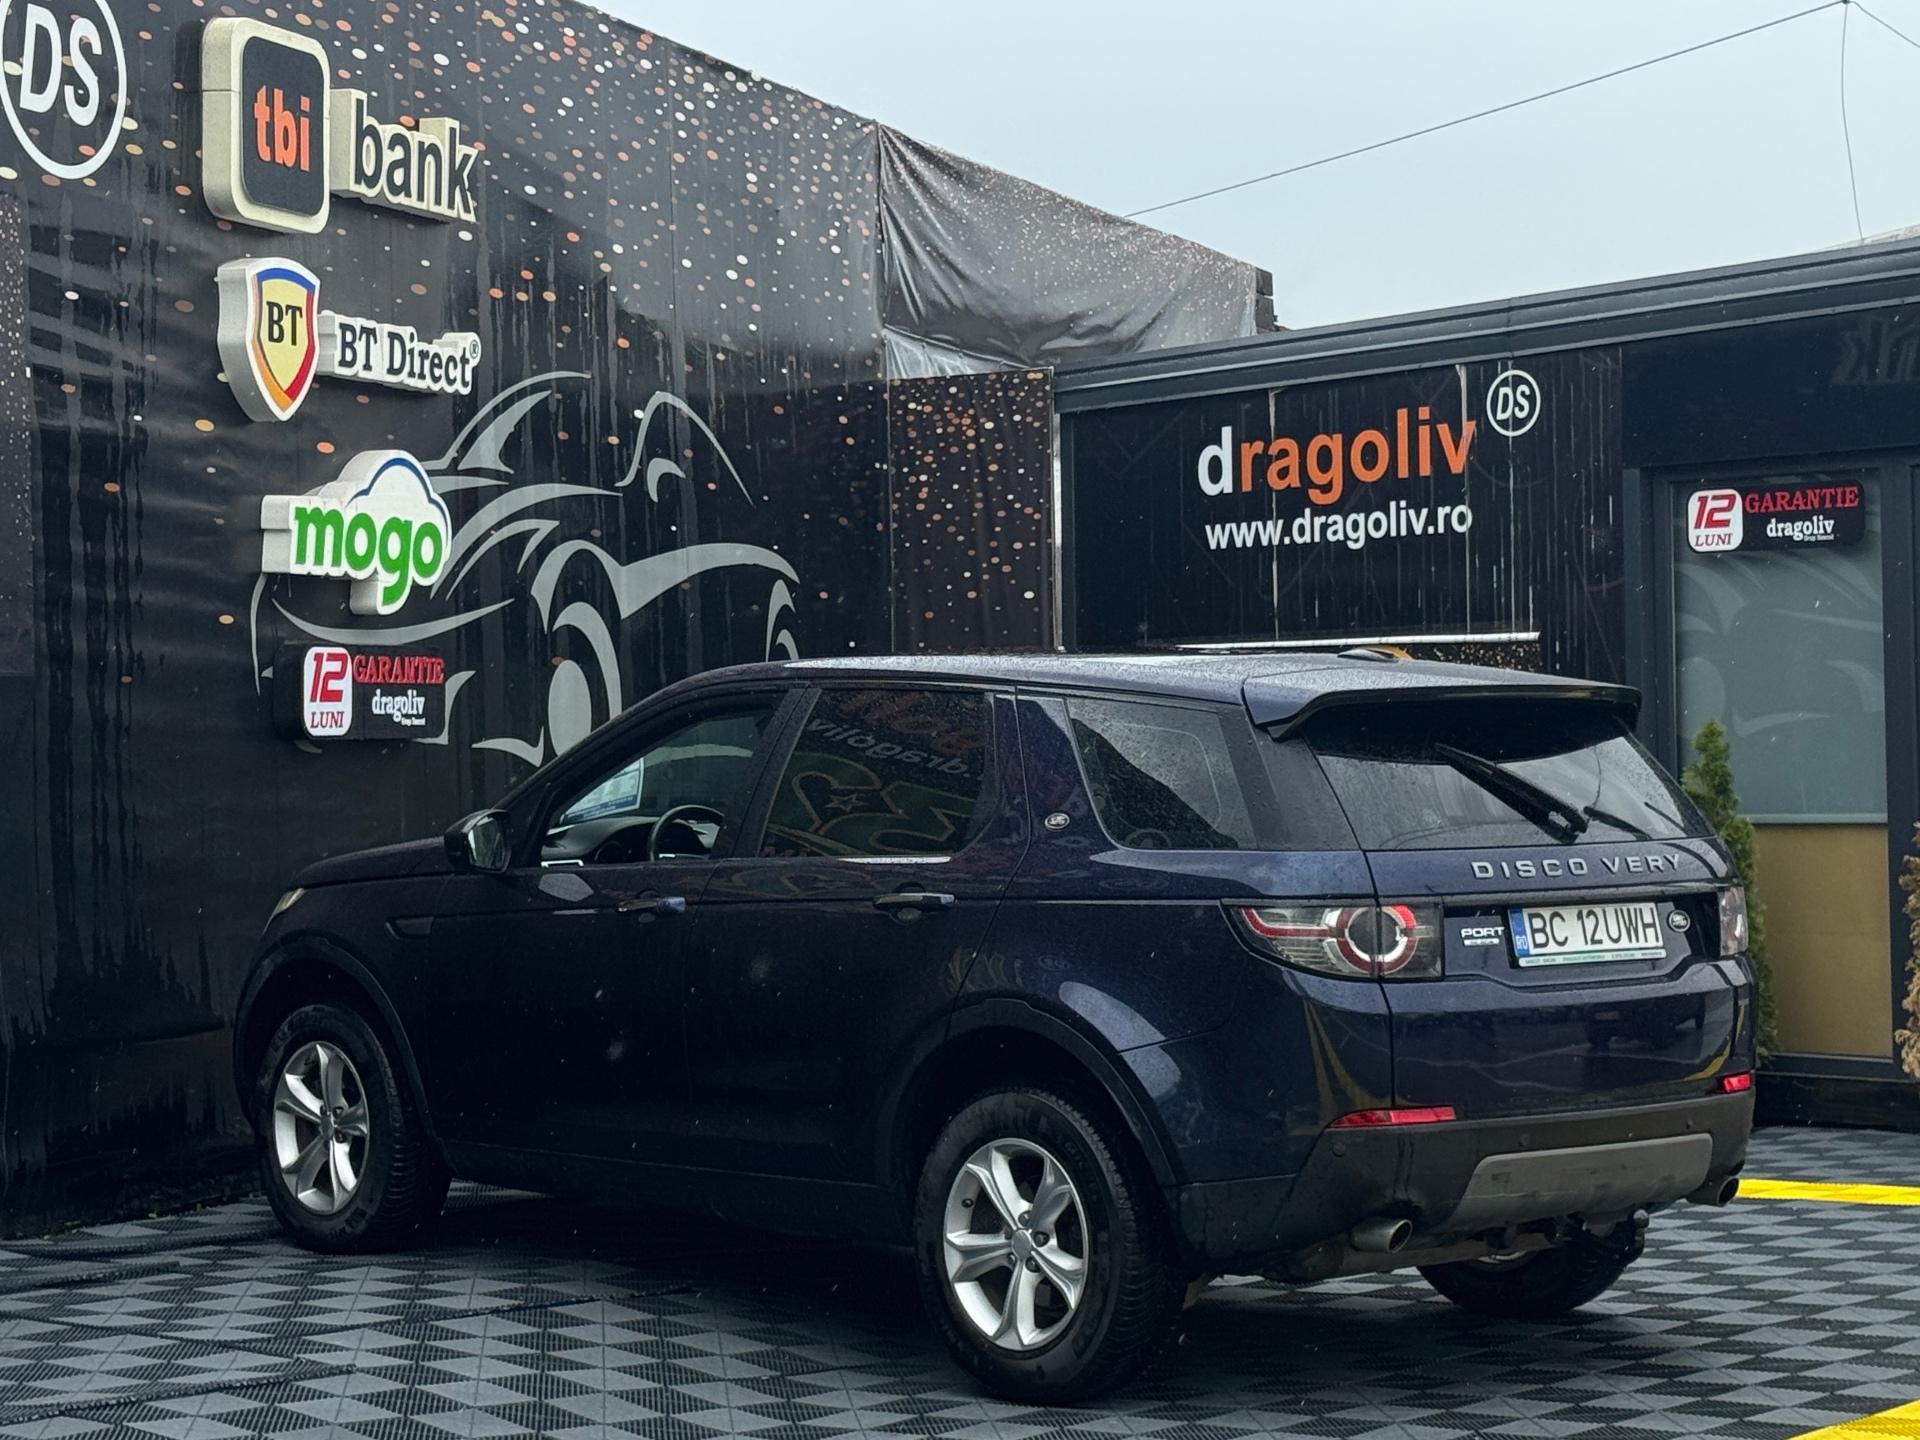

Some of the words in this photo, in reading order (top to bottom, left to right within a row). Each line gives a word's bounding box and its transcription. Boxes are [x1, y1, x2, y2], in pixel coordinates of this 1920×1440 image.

[20, 4, 102, 127] DS
[254, 85, 311, 173] tbi
[354, 98, 476, 215] bank
[267, 301, 303, 347] BT
[338, 322, 377, 371] BT
[1496, 383, 1531, 421] DS
[1198, 406, 1477, 505] dragoliv
[1694, 494, 1736, 530] 12
[1744, 486, 1859, 514] GARANTIE
[1205, 500, 1473, 550] www.dragoliv.ro
[1694, 533, 1732, 547] LUNI
[1766, 515, 1835, 541] dragoliv
[294, 507, 443, 607] mogo
[310, 652, 348, 703] 12
[352, 654, 445, 684] GARANTIE
[310, 711, 344, 729] LUNI
[372, 689, 425, 722] dragoliv
[1461, 926, 1505, 938] PORT
[1528, 911, 1568, 949] BC
